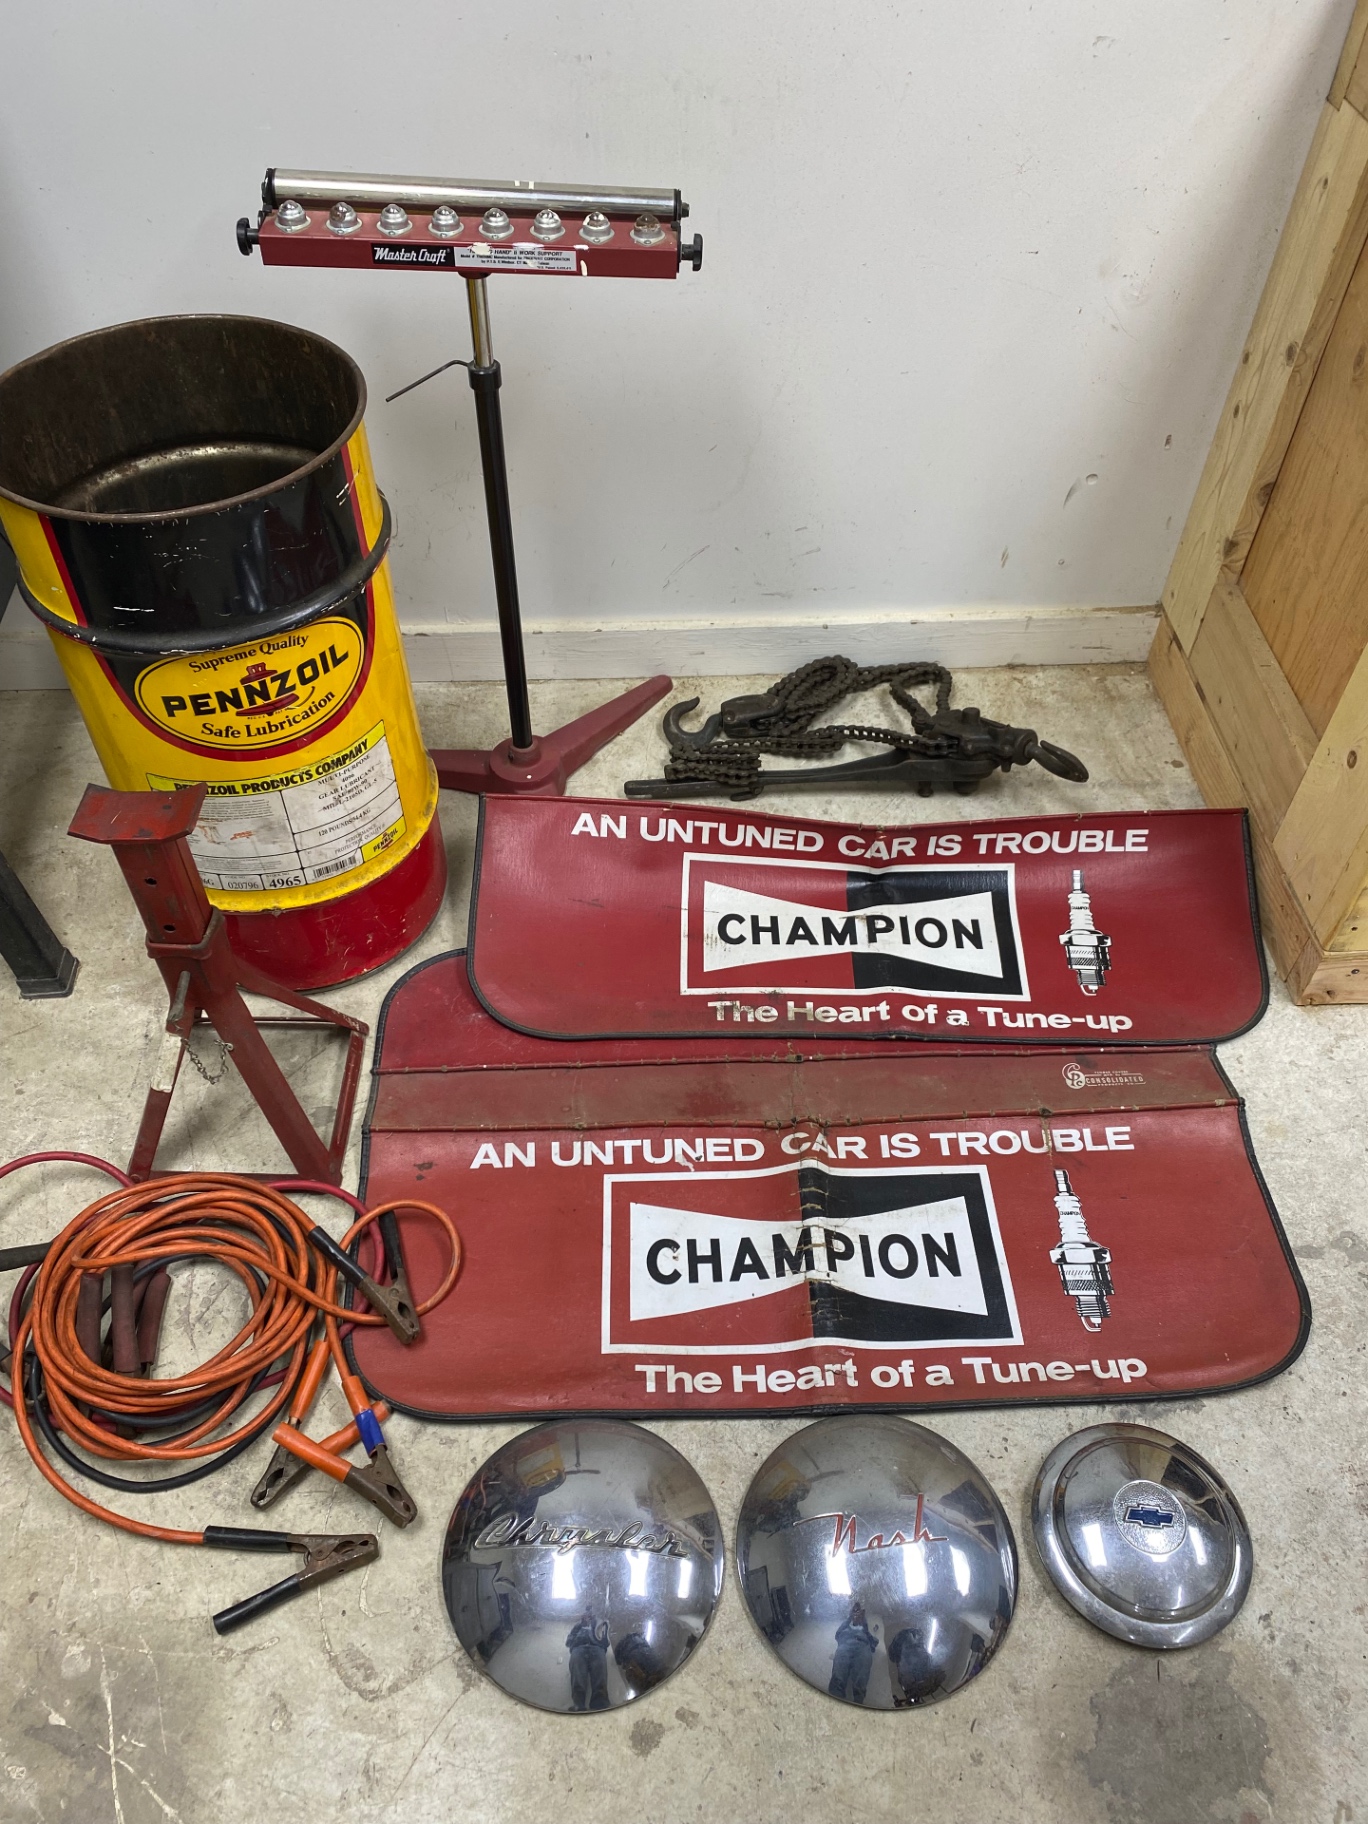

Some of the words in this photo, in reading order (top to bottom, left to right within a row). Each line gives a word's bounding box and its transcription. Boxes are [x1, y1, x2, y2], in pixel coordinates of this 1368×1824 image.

[373, 247, 417, 262] Master
[417, 248, 447, 265] Craft
[188, 646, 257, 674] Supreme
[259, 635, 310, 655] Quality
[160, 644, 350, 718] PENNZOIL
[201, 722, 241, 739] Safe
[245, 691, 336, 738] Lubrication
[240, 769, 314, 793] PRODUCTS
[315, 739, 369, 777] COMPANY
[318, 787, 339, 800] GEAR
[373, 827, 399, 852] PENNZOIL
[571, 812, 627, 839] AN
[639, 816, 825, 853] UNTUNED
[837, 834, 918, 861] CAR
[927, 834, 962, 856] IS
[972, 828, 1149, 855] TROUBLE
[269, 875, 302, 889] 4965
[717, 913, 984, 950] CHAMPION
[707, 1000, 779, 1022] The
[786, 999, 891, 1024] Heart
[901, 1002, 939, 1024] of
[946, 1008, 970, 1026] a
[977, 1006, 1134, 1034] Tune-up
[1085, 1076, 1144, 1084] CONSOLIDATED
[469, 1141, 536, 1169] AN
[551, 1137, 765, 1166] UNTUNED
[780, 1131, 869, 1159] CAR
[879, 1132, 921, 1159] IS
[929, 1126, 1135, 1156] TROUBLE
[646, 1226, 963, 1285] CHAMPION
[634, 1364, 723, 1393] The
[731, 1358, 859, 1394] Heart
[870, 1359, 916, 1388] of
[925, 1364, 955, 1386] a
[961, 1356, 1148, 1384] Tune-up
[472, 1511, 691, 1560] Chrysler
[792, 1492, 950, 1558] Nash
